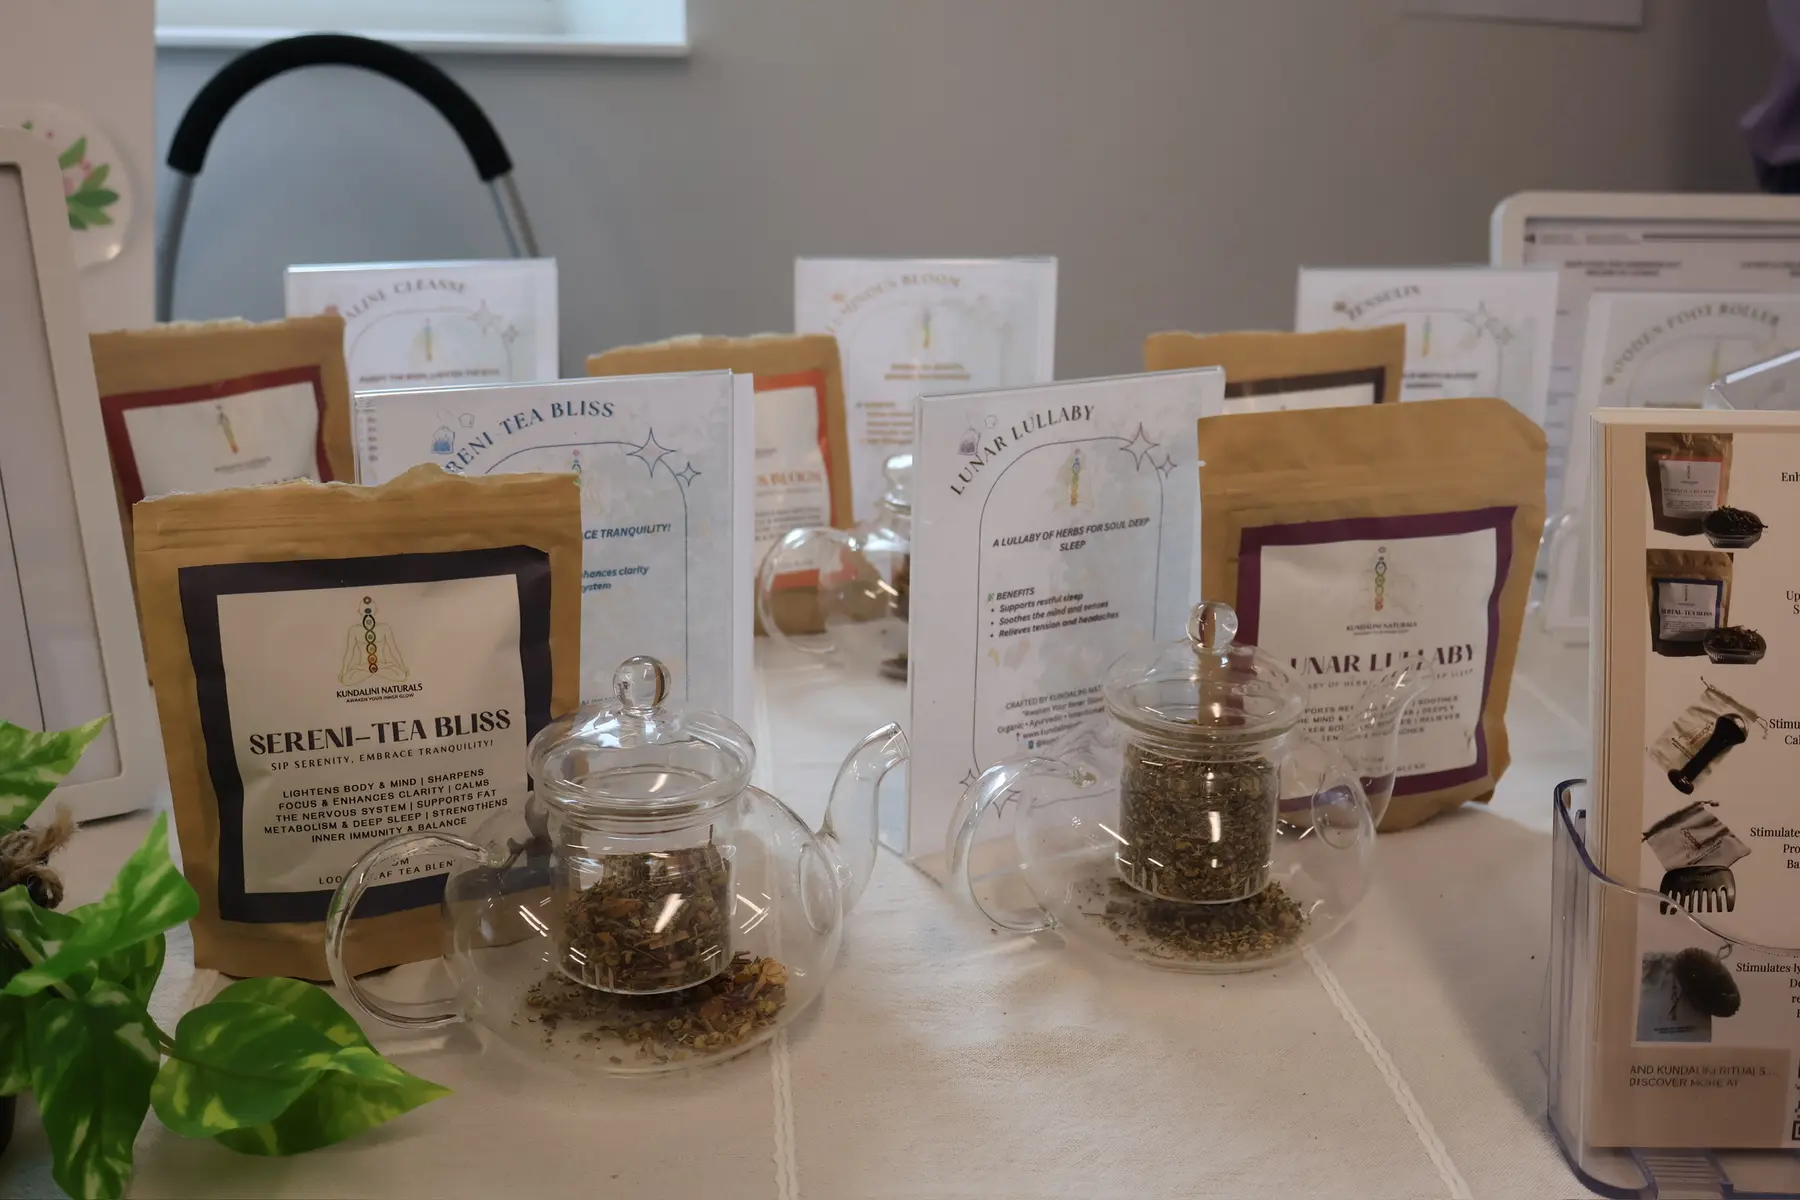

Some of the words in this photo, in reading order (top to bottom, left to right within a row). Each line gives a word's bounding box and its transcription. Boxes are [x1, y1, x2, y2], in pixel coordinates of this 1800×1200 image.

[551, 400, 616, 418] BLISS
[950, 436, 1008, 495] LUNAR
[1011, 405, 1094, 440] LULLABY
[600, 523, 671, 538] TRANQUILITY!
[993, 538, 999, 548] A
[1001, 532, 1042, 547] LULLABY
[1042, 530, 1055, 541] OF
[1055, 526, 1084, 539] HERBS
[1086, 523, 1103, 534] FOR
[1104, 521, 1126, 532] SOUL
[1128, 517, 1151, 528] DEEP
[1059, 540, 1086, 552] SLEEP
[618, 565, 649, 576] clarity
[996, 587, 1035, 601] BENEFITS
[999, 601, 1035, 614] Supports
[1036, 596, 1062, 607] restful
[1063, 592, 1084, 603] sleep
[999, 614, 1031, 626] Soothes
[1032, 610, 1045, 621] the
[1046, 605, 1066, 617] mind
[1067, 602, 1083, 613] and
[1083, 600, 1109, 610] senses
[998, 626, 1031, 638] Relieves
[1032, 622, 1061, 633] tension
[1062, 617, 1077, 628] and
[1078, 611, 1119, 625] headaches
[336, 687, 380, 698] KUNDALINI
[381, 683, 423, 694] NATURALS
[1005, 697, 1038, 710] CRAFTED
[1039, 696, 1049, 704] BY
[435, 708, 511, 738] BLISS
[271, 762, 289, 771] SIP
[294, 756, 354, 769] SERENITY,
[359, 749, 413, 762] EMBRACE
[419, 740, 494, 756] TRANQUILITY!
[283, 786, 340, 799] LIGHTENS
[344, 782, 374, 793] BODY
[379, 781, 386, 790] &
[390, 778, 417, 788] MIND
[428, 768, 484, 784] SHARPENS
[276, 813, 298, 822] THE
[302, 808, 357, 821] NERVOUS
[361, 803, 406, 815] SYSTEM
[417, 793, 473, 809] SUPPORTS
[477, 789, 497, 799] FAT
[279, 799, 317, 811] FOCUS
[322, 798, 328, 807] &
[333, 792, 394, 806] ENHANCES
[398, 785, 445, 799] CLARITY
[455, 779, 490, 791] CALMS
[264, 821, 337, 834] METABOLISM
[342, 821, 348, 829] &
[353, 817, 383, 828] DEEP
[387, 812, 422, 824] SLEEP
[432, 798, 508, 818] STRENGTHENS
[312, 833, 345, 843] INNER
[350, 826, 403, 840] IMMUNITY
[418, 816, 467, 831] BALANCE
[400, 866, 420, 876] TEA
[425, 858, 457, 872] BLEN
[1736, 962, 1791, 973] Stimulates
[1629, 1065, 1654, 1075] AND
[1629, 1077, 1687, 1088] DISCOVER
